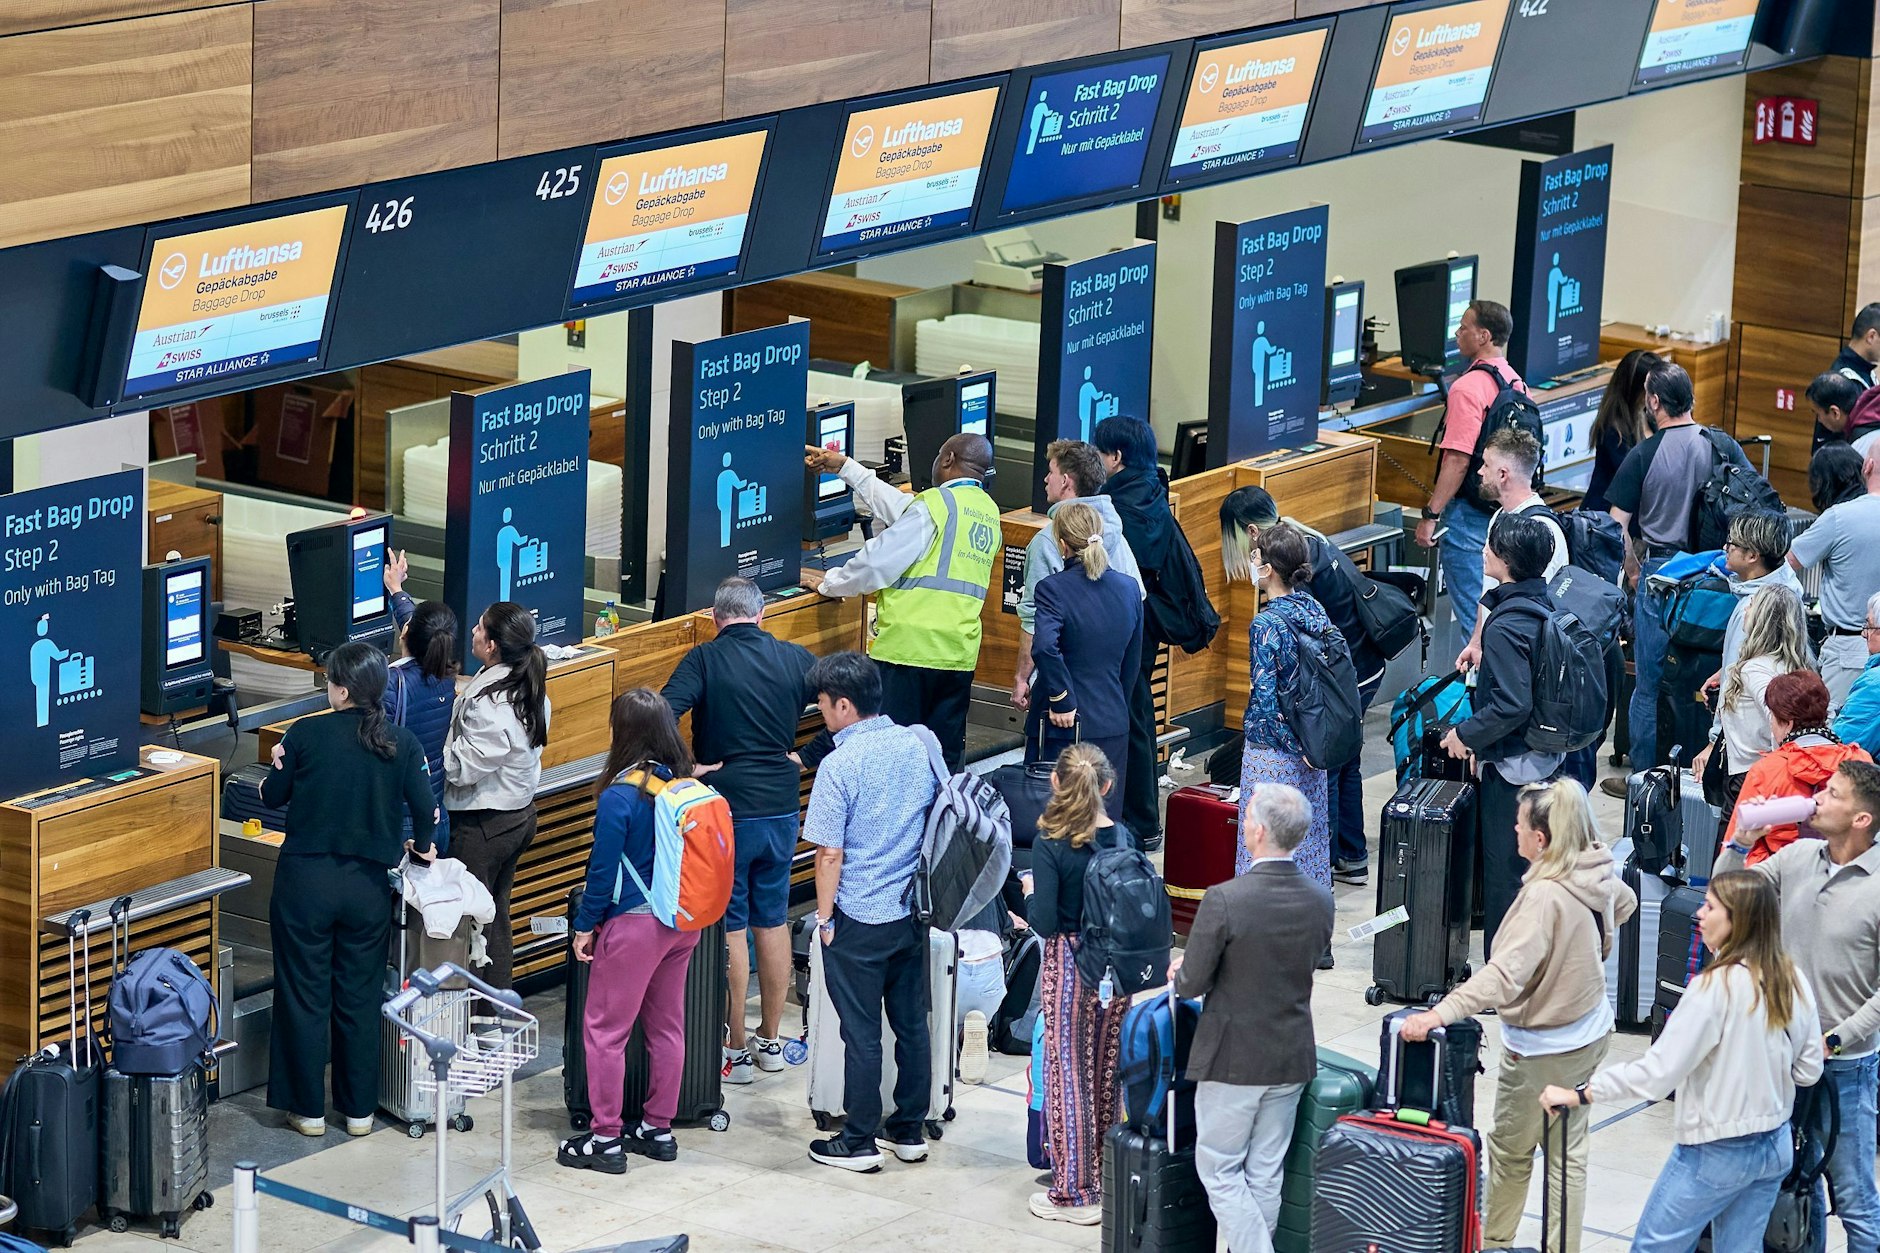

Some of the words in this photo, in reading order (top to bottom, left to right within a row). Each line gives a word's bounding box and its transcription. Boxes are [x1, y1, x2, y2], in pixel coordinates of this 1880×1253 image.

[1519, 0, 1548, 18] 422
[1416, 21, 1482, 49] Lufthansa
[1413, 44, 1464, 61] Gepäckabgabe
[1225, 54, 1296, 85] Lufthansa
[1665, 62, 1681, 74] STAR
[1682, 57, 1713, 70] ALLIANCE
[1074, 81, 1102, 103] Fast
[1102, 78, 1128, 101] Bag
[1129, 72, 1158, 96] Drop
[1222, 79, 1277, 98] Gepäckabgabe
[1068, 106, 1108, 128] Schritt
[1109, 102, 1120, 121] 2
[1218, 101, 1250, 114] Baggage
[1250, 96, 1268, 108] Drop
[1392, 104, 1412, 115] SWISS
[882, 118, 963, 148] Lufthansa
[1190, 126, 1220, 141] Austrian
[1392, 120, 1411, 131] STAR
[1411, 112, 1444, 128] ALLIANCE
[879, 142, 943, 164] Gepäckabgabe
[1060, 142, 1078, 156] Nur
[1078, 138, 1094, 154] mit
[1095, 128, 1145, 151] Gepäcklabel
[1200, 142, 1222, 155] SWISS
[876, 162, 910, 180] Baggage
[912, 158, 932, 173] Drop
[1202, 159, 1221, 171] STAR
[1222, 151, 1257, 167] ALLIANCE
[536, 164, 582, 201] 425
[639, 162, 728, 195] Lufthansa
[926, 177, 950, 190] brussels
[1544, 173, 1562, 192] Fast
[1564, 168, 1582, 188] Bag
[1584, 162, 1608, 181] Drop
[636, 188, 706, 211] Gepäckabgabe
[844, 192, 878, 209] Austrian
[1542, 194, 1570, 217] Schritt
[1572, 192, 1578, 208] 2
[365, 196, 414, 234] 426
[632, 210, 671, 228] Baggage
[673, 205, 695, 222] Drop
[857, 210, 881, 225] SWISS
[1540, 231, 1551, 242] Nur
[1552, 226, 1563, 239] mit
[1564, 213, 1604, 236] Gepäcklabel
[688, 224, 714, 238] brussels
[859, 226, 882, 241] STAR
[882, 219, 923, 237] ALLIANCE
[1242, 234, 1264, 256] Fast
[1267, 230, 1290, 251] Bag
[1292, 223, 1322, 244] Drop
[199, 240, 303, 278] Lufthansa
[597, 240, 635, 259] Austrian
[612, 260, 638, 275] SWISS
[615, 276, 640, 292] STAR
[640, 268, 686, 288] ALLIANCE
[1240, 262, 1264, 282] Step
[1267, 258, 1274, 275] 2
[196, 269, 278, 295] Gepäckabgabe
[1070, 276, 1092, 299] Fast
[1094, 271, 1116, 294] Bag
[1120, 263, 1148, 285] Drop
[192, 295, 238, 313] Baggage
[240, 288, 266, 304] Drop
[1239, 296, 1256, 310] Only
[1258, 289, 1274, 304] with
[1276, 286, 1291, 300] Bag
[1294, 282, 1308, 298] Tag
[260, 308, 290, 322] brussels
[1068, 301, 1104, 327] Schritt
[1106, 297, 1113, 316] 2
[153, 328, 197, 348] Austrian
[1066, 340, 1080, 354] Nur
[1082, 334, 1094, 350] mit
[1096, 320, 1144, 346] Gepäcklabel
[172, 349, 202, 364] SWISS
[176, 368, 204, 382] STAR
[204, 356, 258, 376] ALLIANCE
[701, 355, 729, 380] Fast
[733, 351, 760, 374] Bag
[766, 342, 801, 367] Drop
[700, 382, 728, 410] Step
[733, 382, 742, 402] 2
[481, 408, 510, 432] Fast
[514, 402, 542, 426] Bag
[546, 392, 583, 416] Drop
[698, 424, 720, 441] Only
[722, 416, 743, 434] with
[746, 414, 764, 430] Bag
[767, 408, 786, 425] Tag
[480, 437, 526, 464] Schritt
[529, 430, 538, 450] 2
[478, 480, 496, 496] Nur
[498, 473, 516, 490] mit
[517, 456, 579, 484] Gepäcklabel
[5, 512, 42, 538] Fast
[47, 506, 82, 532] Bag
[88, 493, 134, 522] Drop
[5, 547, 43, 572] Step
[48, 540, 59, 562] 2
[4, 586, 31, 607] Only
[35, 576, 62, 600] with
[66, 574, 90, 592] Bag
[93, 568, 116, 587] Tag
